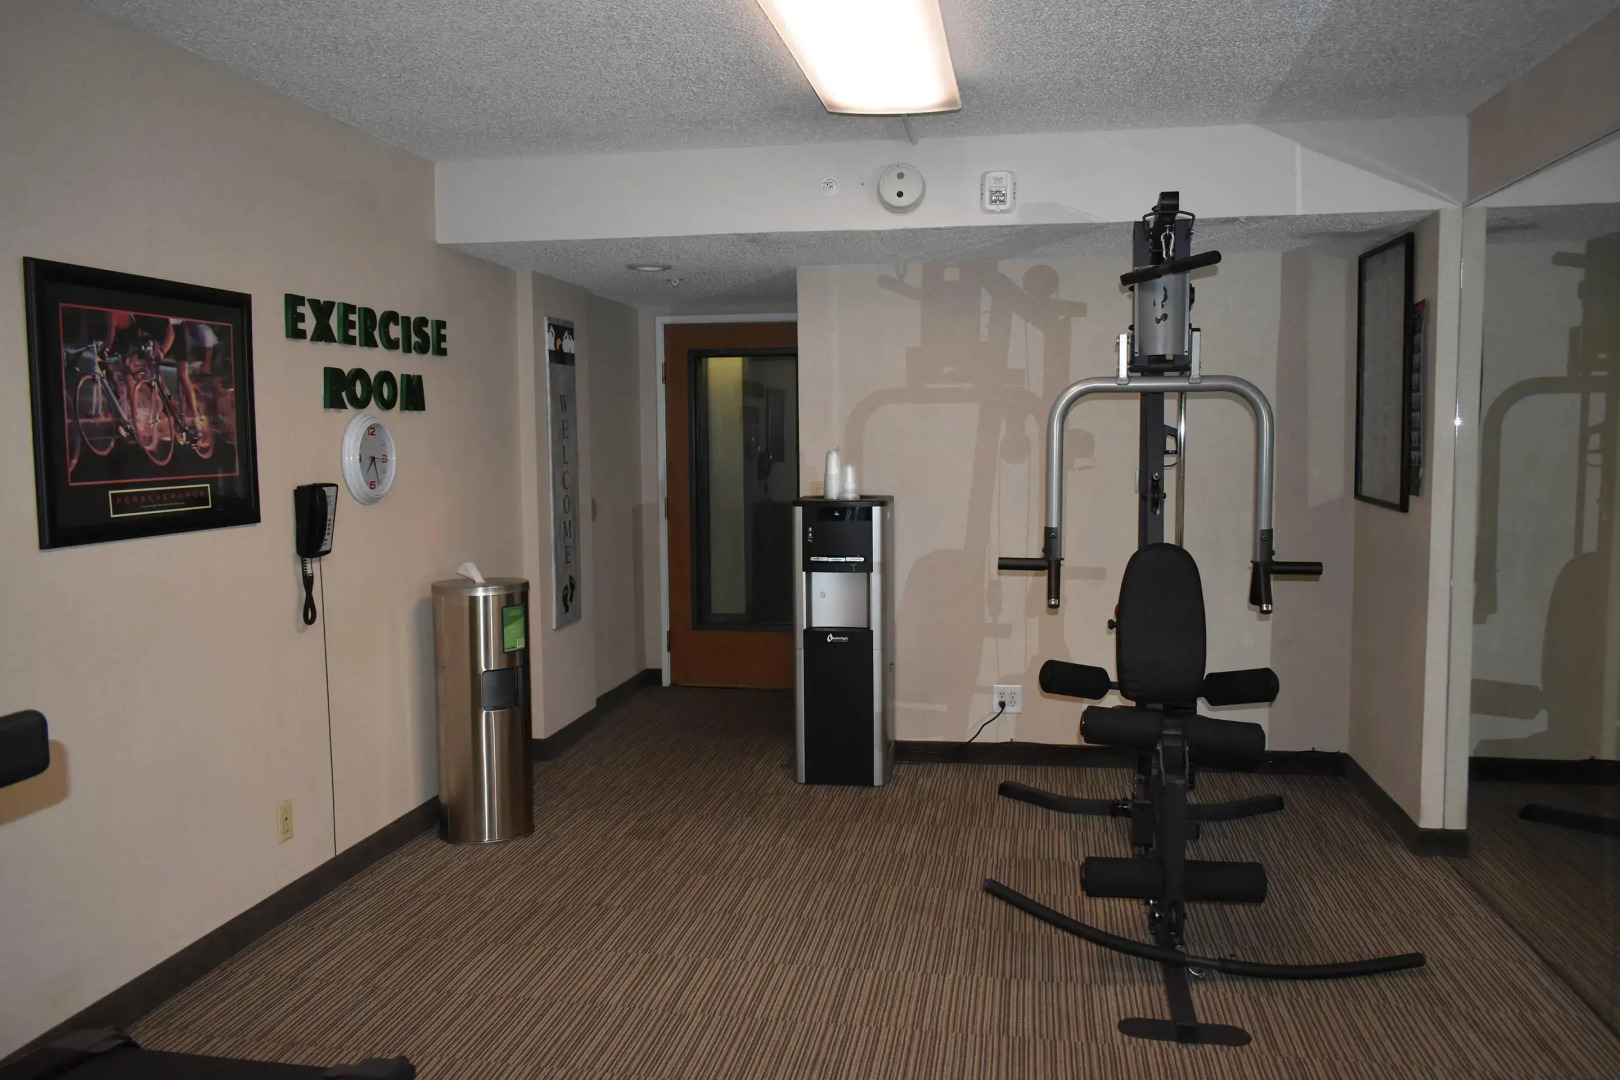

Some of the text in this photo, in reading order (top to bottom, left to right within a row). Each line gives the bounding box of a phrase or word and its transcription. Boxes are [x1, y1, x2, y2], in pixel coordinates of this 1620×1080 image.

[284, 293, 447, 356] EXERCISE
[323, 367, 425, 411] ROOM
[367, 427, 376, 436] 12
[369, 480, 376, 489] 6
[559, 394, 573, 564] WELCOME
[116, 491, 204, 504] PERSEVERANCE
